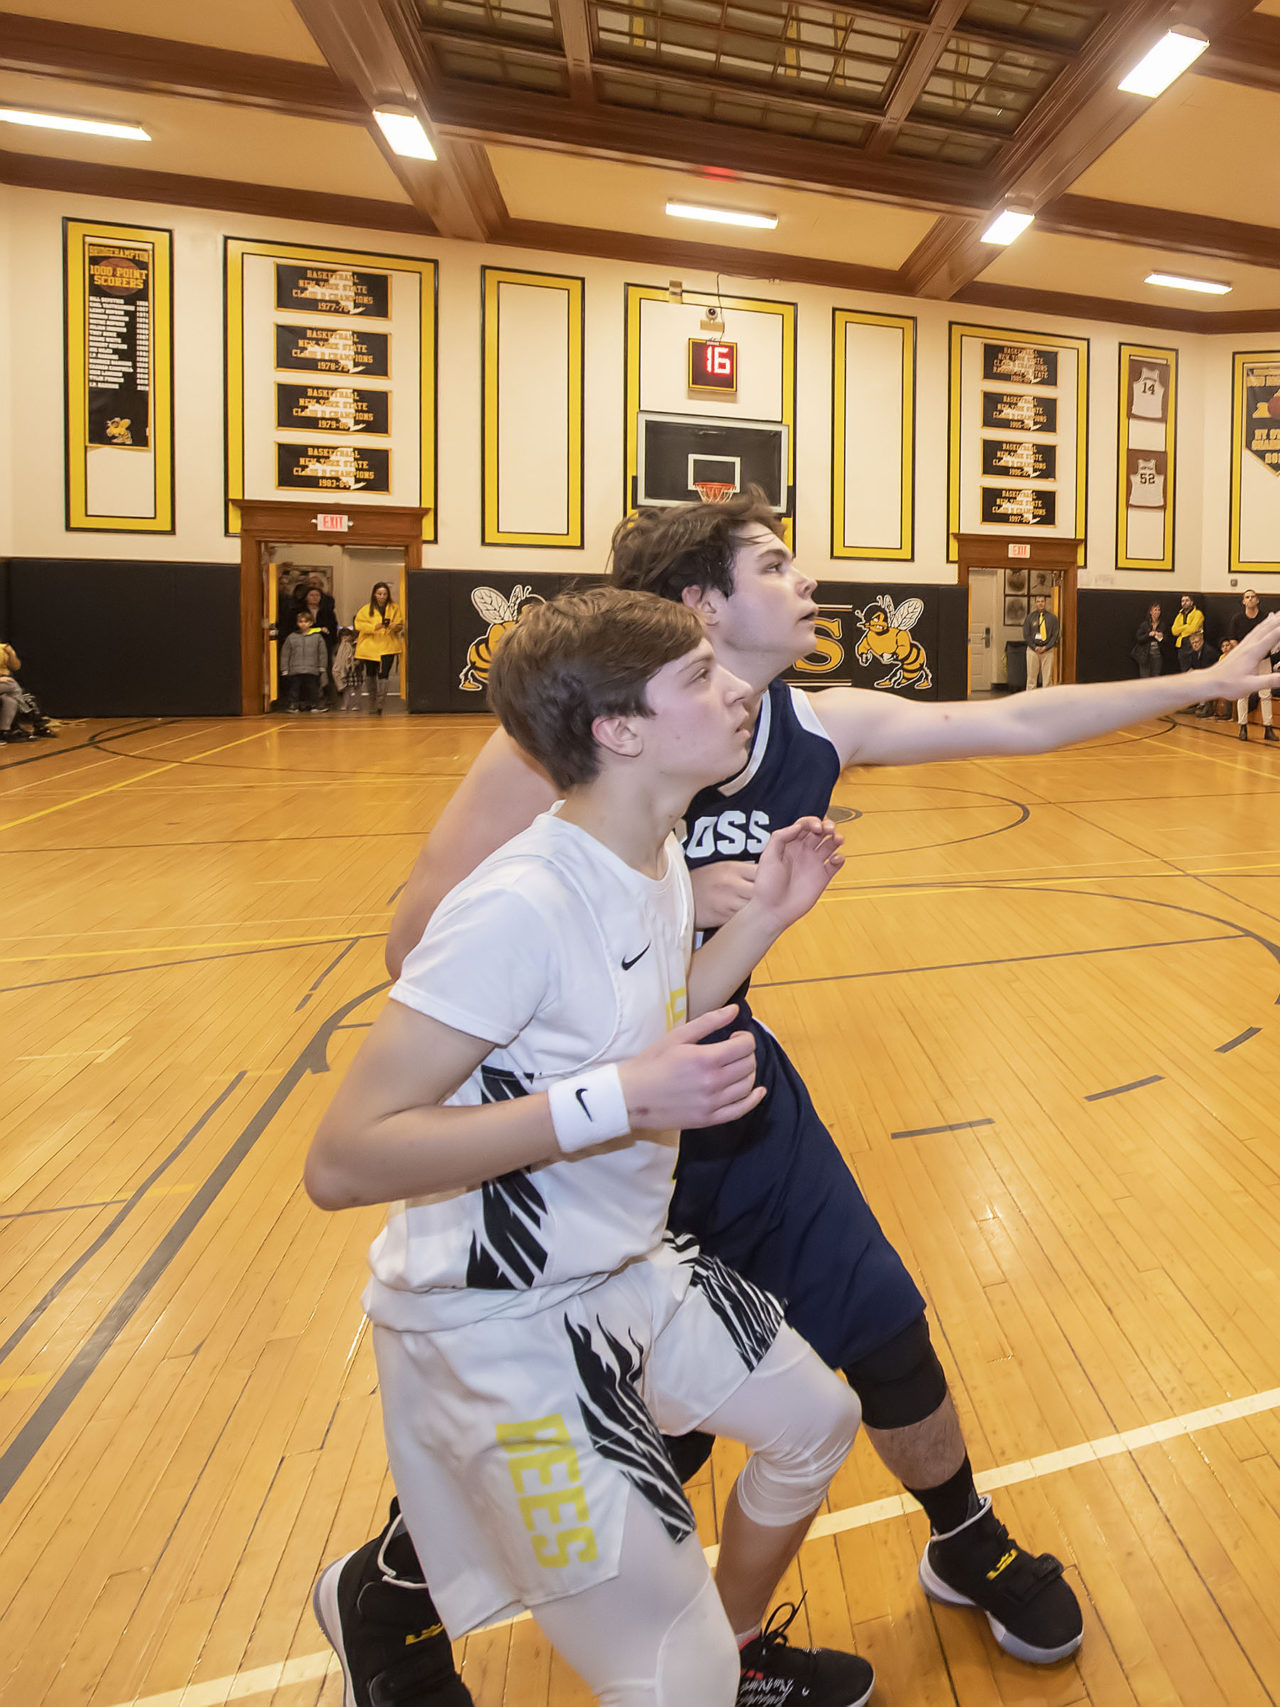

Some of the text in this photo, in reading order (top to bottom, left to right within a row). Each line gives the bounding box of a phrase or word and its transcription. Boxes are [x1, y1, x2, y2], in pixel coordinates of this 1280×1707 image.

[90, 265, 148, 280] 1000 POINT
[307, 270, 359, 282] BASKETBALL
[94, 275, 143, 289] SCORERS
[298, 280, 316, 289] NEW
[343, 283, 368, 294] STATE
[328, 291, 374, 304] CHAMPIONS
[307, 330, 359, 341] BASKETBALL
[298, 339, 316, 348] NEW
[343, 343, 368, 353] STATE
[328, 351, 373, 363] CHAMPIONS
[707, 346, 731, 375] 16
[307, 388, 359, 400] BASKETBALL
[1142, 382, 1156, 395] 14
[299, 398, 317, 407] NEW
[343, 401, 368, 410] STATE
[329, 410, 373, 421] CHAMPIONS
[308, 447, 360, 458] BASKETBALL
[299, 457, 318, 466] NEW
[343, 460, 369, 469] STATE
[329, 469, 374, 479] CHAMPIONS
[1140, 473, 1156, 485] 52
[322, 515, 344, 529] EXIT
[1012, 545, 1027, 556] EXIT
[496, 1412, 598, 1568] BEES
